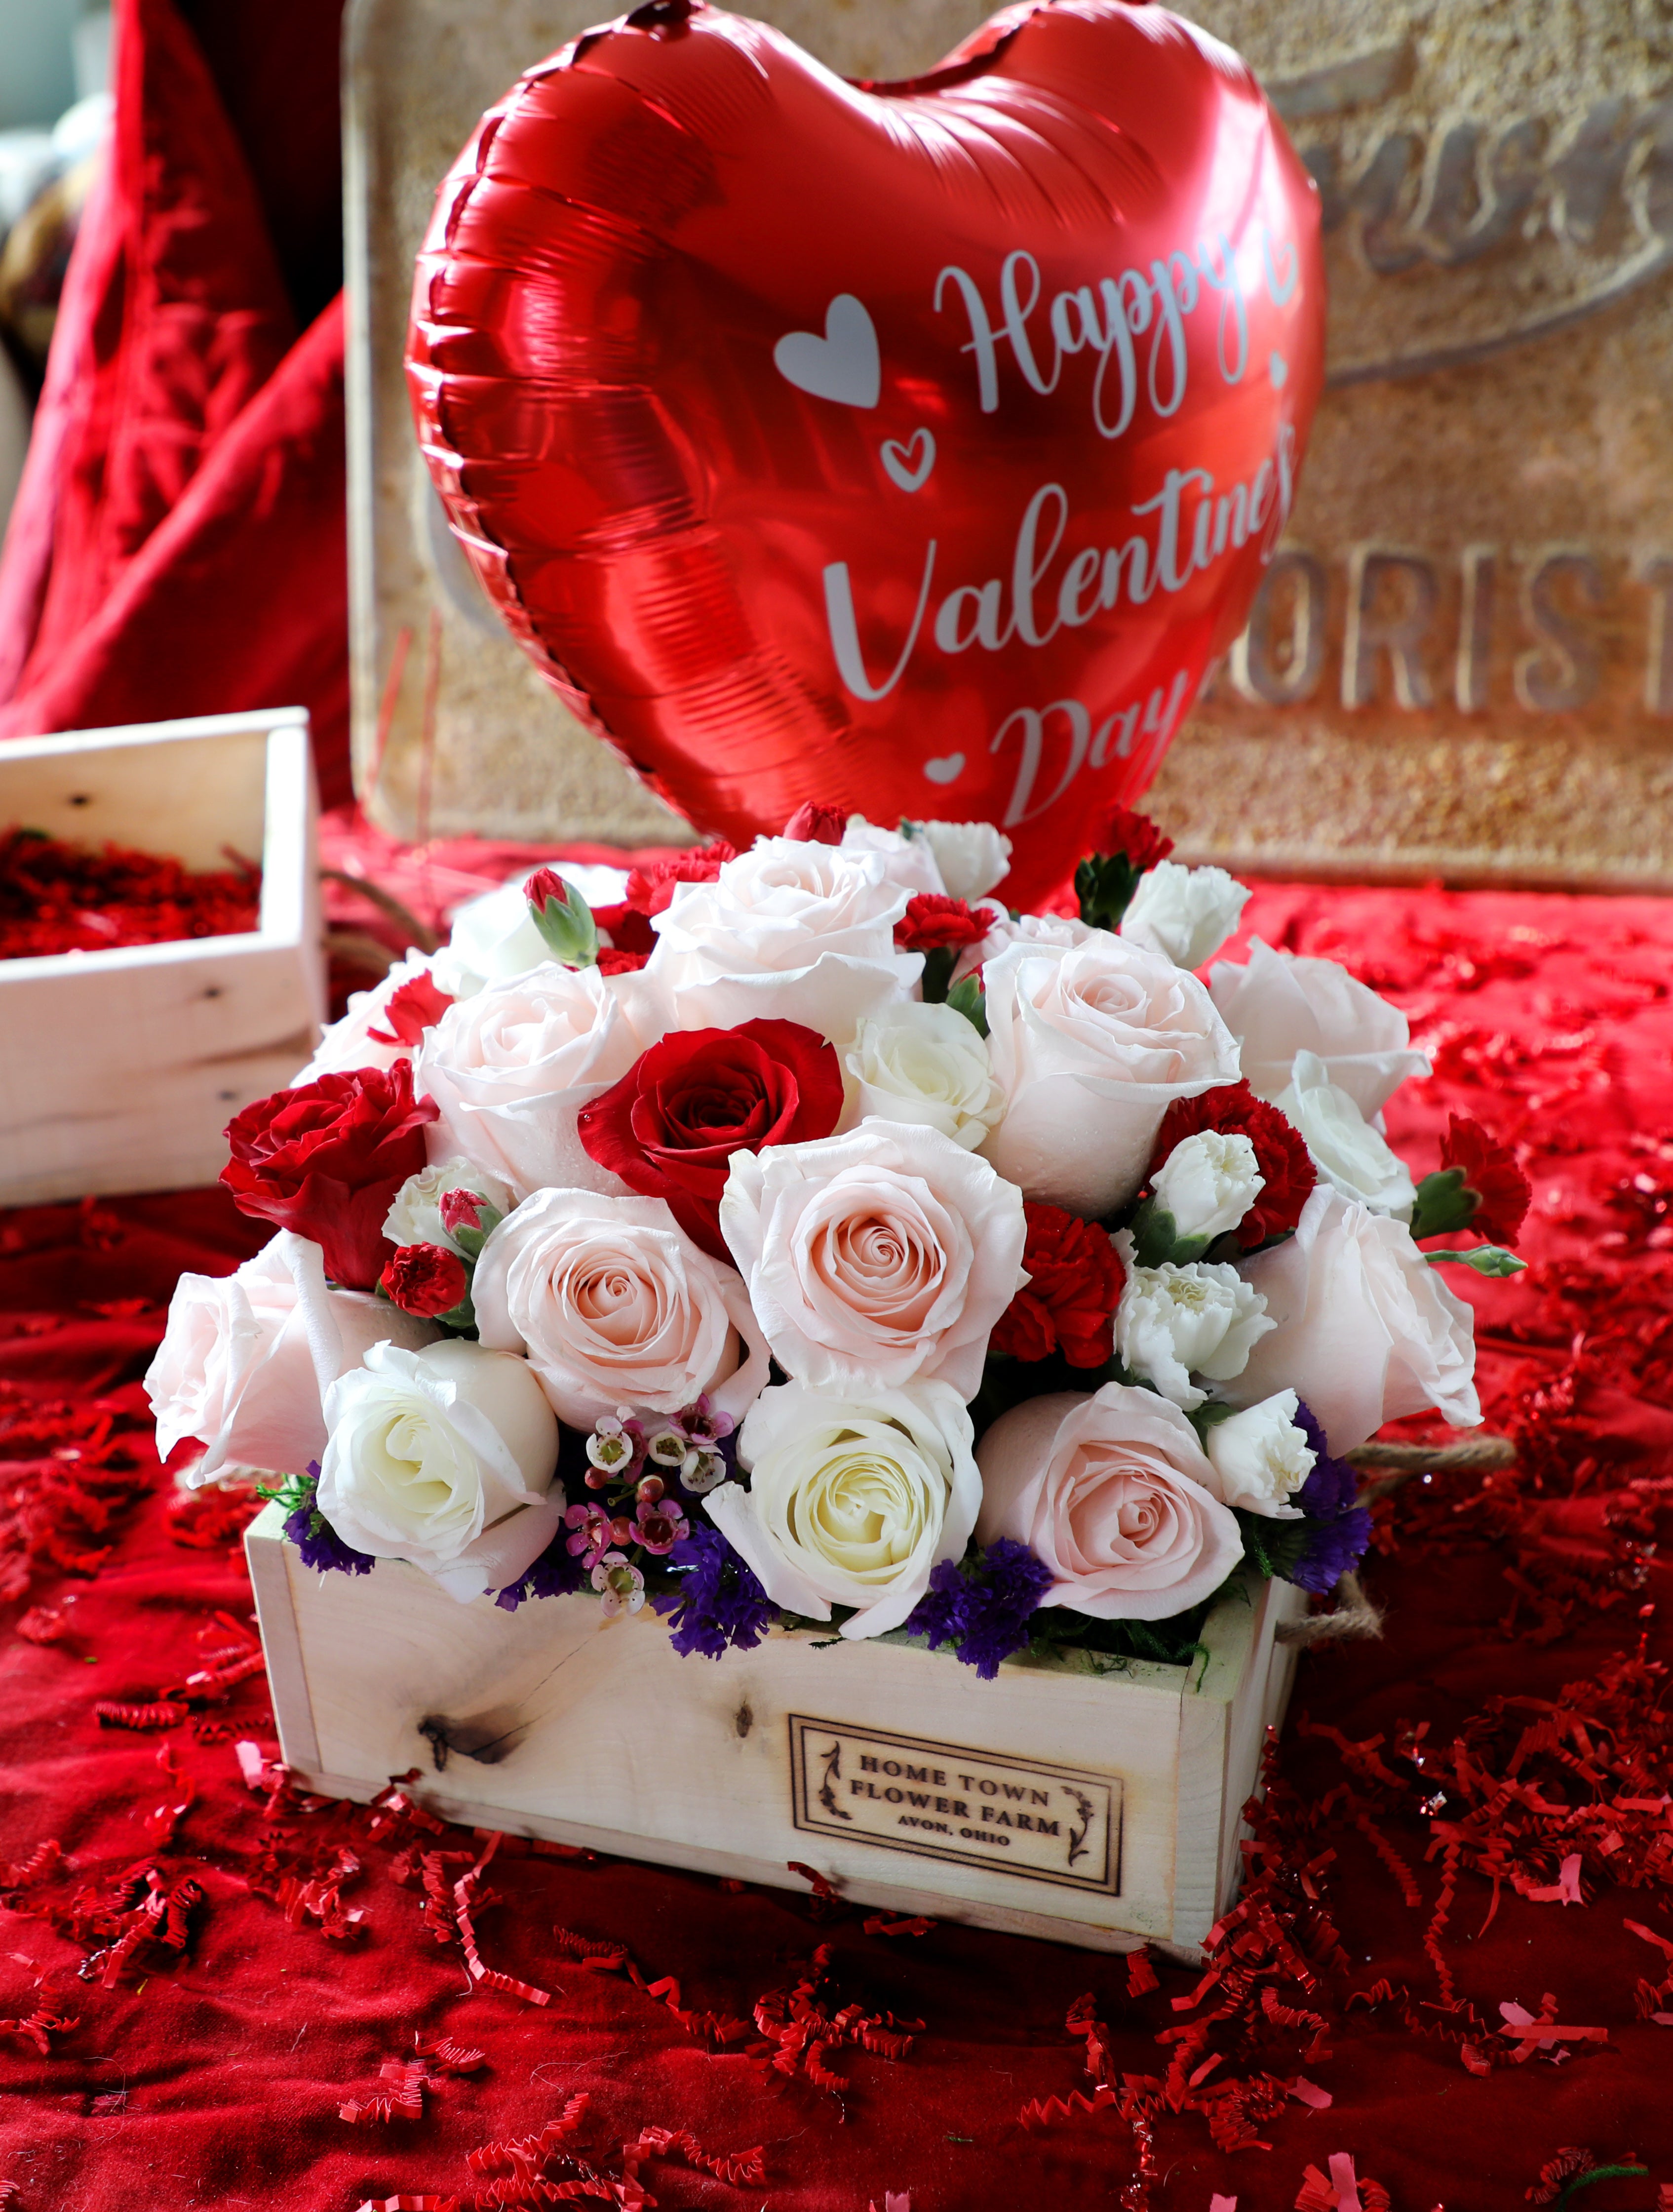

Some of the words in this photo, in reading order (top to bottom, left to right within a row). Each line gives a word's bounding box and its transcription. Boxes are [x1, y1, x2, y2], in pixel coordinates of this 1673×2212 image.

[933, 233, 1249, 439] Happy
[989, 669, 1188, 829] Day
[850, 1779, 970, 1818] FLOWER
[981, 1806, 1061, 1836] FARM
[859, 1755, 947, 1786] HOME
[958, 1775, 1049, 1807] TOWN
[897, 1815, 953, 1836] AVON,
[960, 1827, 1011, 1847] OHIO
